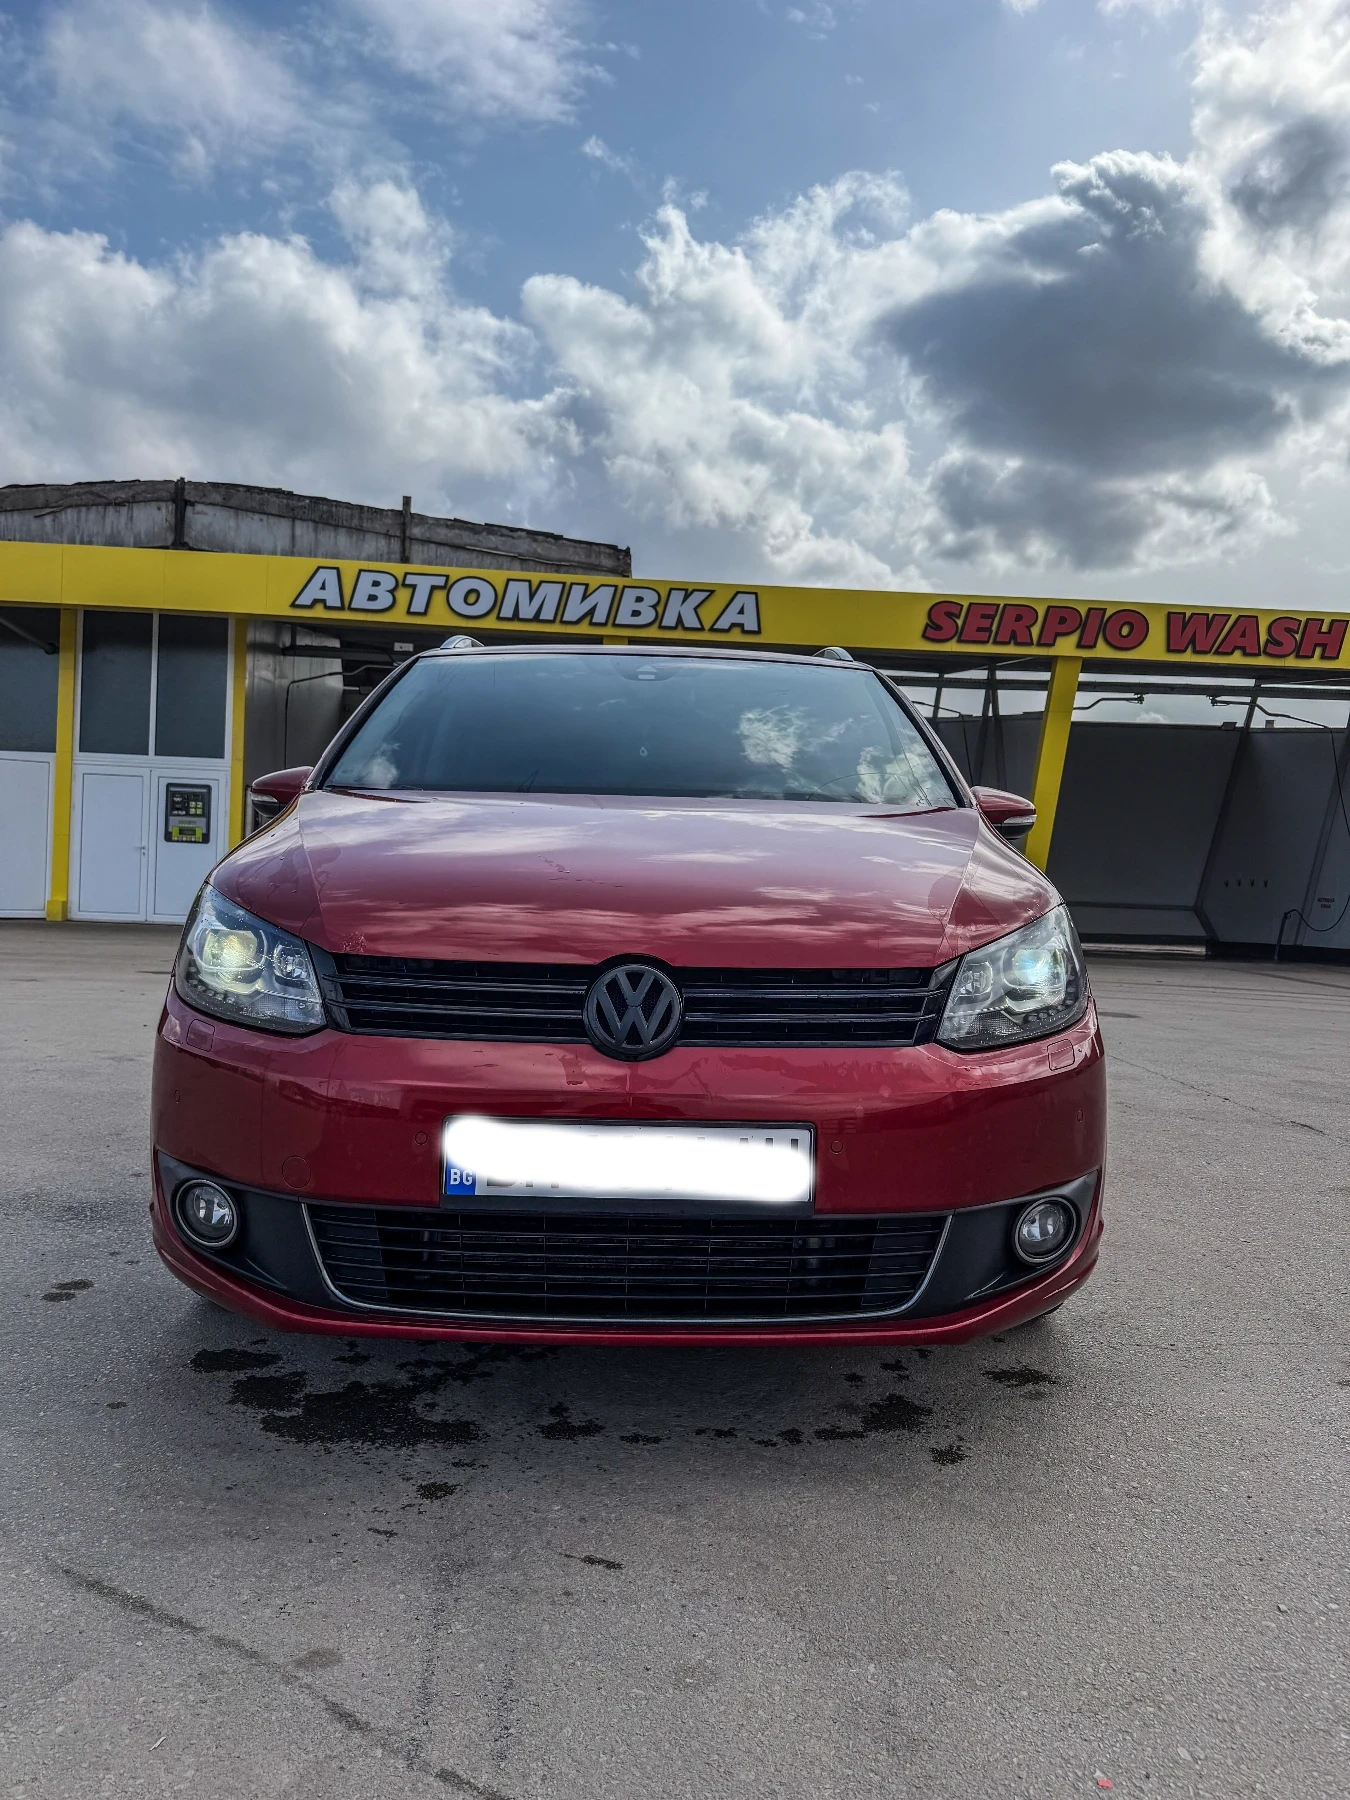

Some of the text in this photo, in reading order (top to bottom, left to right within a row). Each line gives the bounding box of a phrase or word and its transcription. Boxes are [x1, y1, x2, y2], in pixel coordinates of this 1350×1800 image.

[290, 566, 762, 634] АВТОМИВКА
[921, 600, 1350, 660] SERPIO WASH
[588, 965, 681, 1053] VW
[450, 1168, 473, 1186] BG
